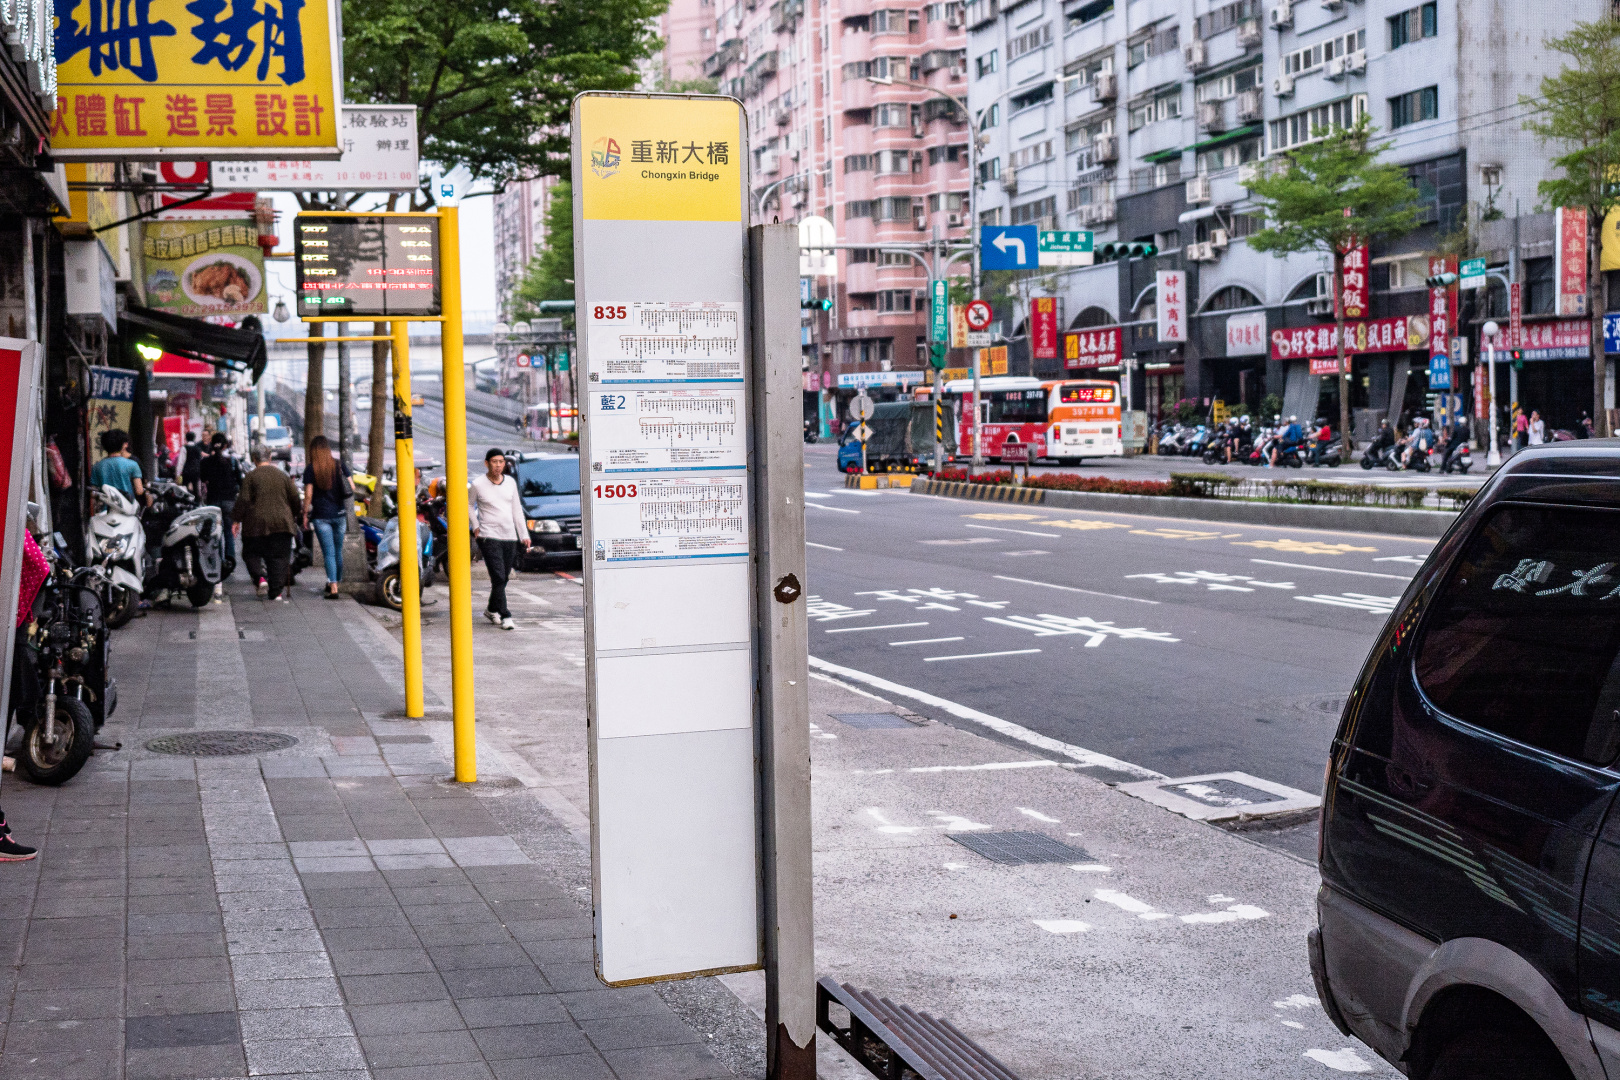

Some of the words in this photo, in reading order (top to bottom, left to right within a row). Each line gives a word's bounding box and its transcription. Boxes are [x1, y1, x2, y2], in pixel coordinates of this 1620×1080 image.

[165, 93, 238, 137] 造景
[255, 94, 324, 136] 設計
[343, 113, 408, 128] 檢驗站
[630, 140, 729, 165] 重新大橋
[268, 173, 324, 181] 週一至週六
[641, 170, 686, 182] Chongxin
[689, 171, 720, 181] Bridge
[1565, 220, 1583, 292] 汽車電機
[594, 306, 627, 320] 835
[936, 295, 945, 324] 成功路
[1290, 324, 1358, 354] 好客雞肉飯
[1368, 320, 1407, 348] 虱目魚
[600, 395, 626, 411] 藍2
[1072, 408, 1104, 416] 397-FM
[593, 484, 638, 499] 1503
